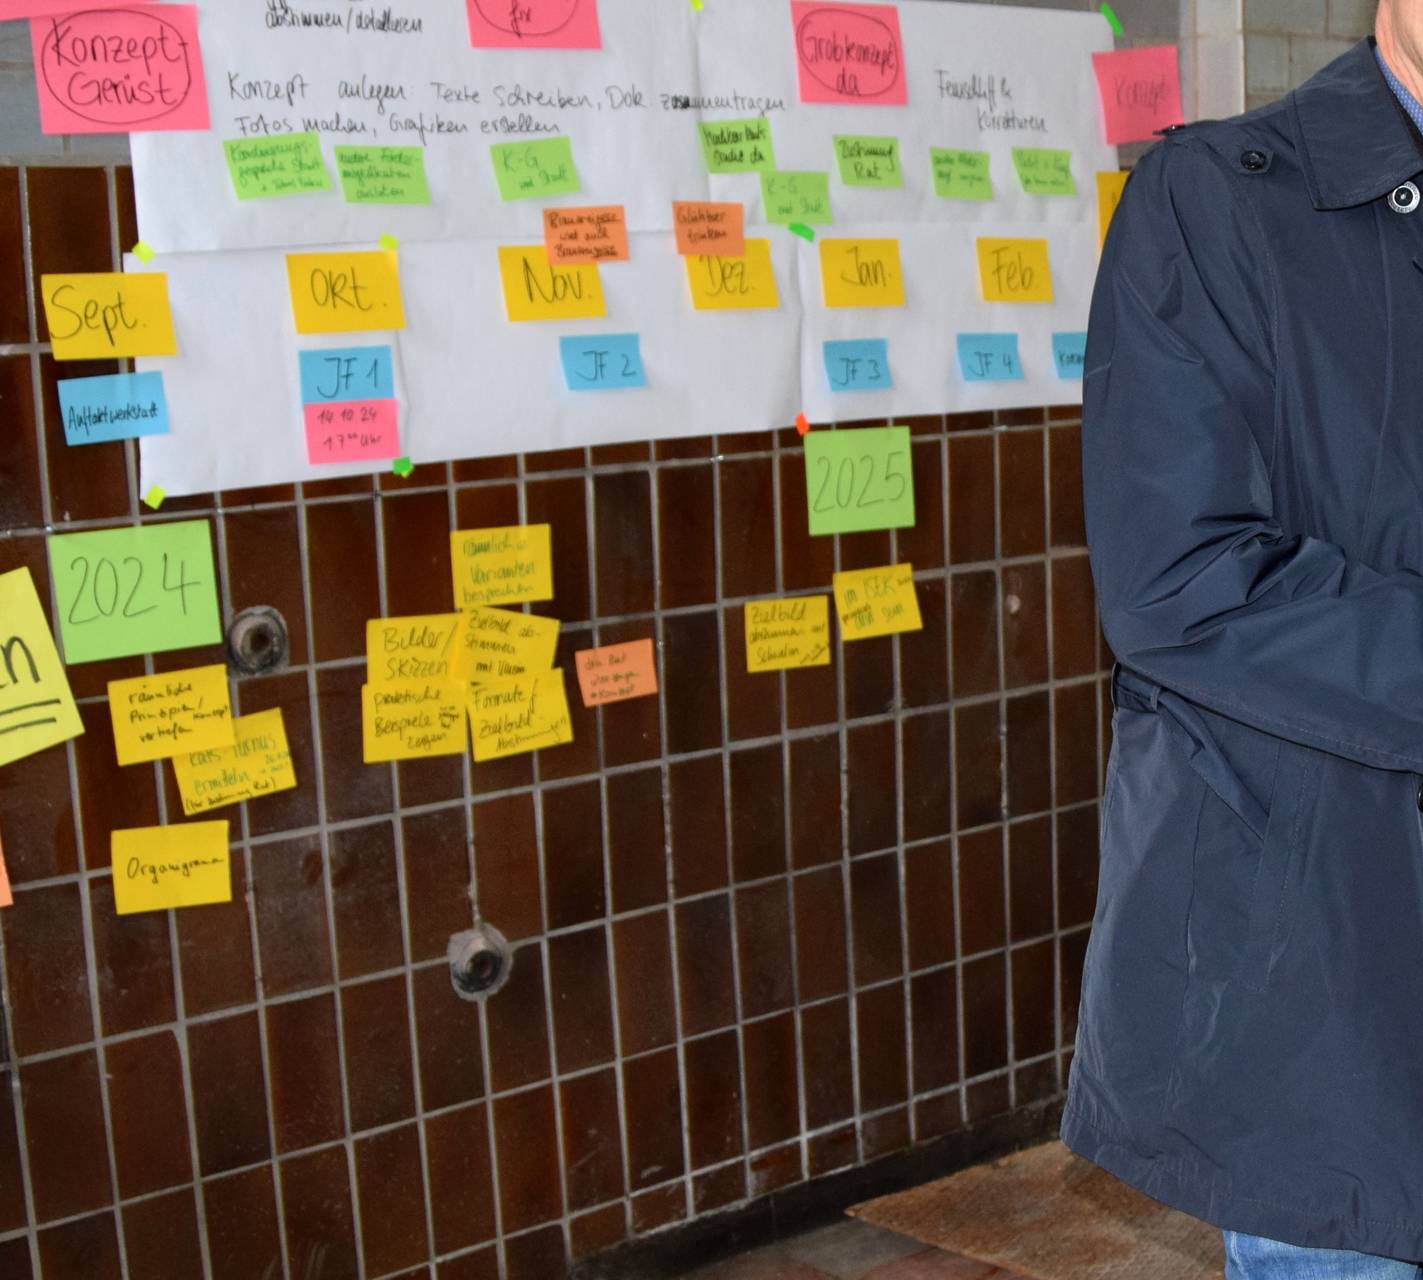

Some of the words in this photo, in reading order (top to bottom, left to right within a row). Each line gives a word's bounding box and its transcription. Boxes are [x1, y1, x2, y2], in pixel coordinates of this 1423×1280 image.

[68, 71, 179, 106] Gerüst
[227, 71, 309, 107] Konzept
[430, 81, 481, 105] Texte
[605, 84, 646, 110] Dok
[836, 67, 860, 97] da
[233, 113, 293, 136] Fotos
[389, 112, 468, 147] Grafiken
[480, 112, 560, 134] erstellen
[749, 144, 765, 164] da
[853, 160, 882, 180] Rat
[521, 256, 593, 304] Nov.
[839, 246, 893, 288] Jan.
[308, 265, 390, 313] Okt.
[49, 284, 148, 347] Sept.
[364, 352, 380, 389] 1
[620, 352, 637, 379] 2
[866, 358, 882, 381] 3
[1002, 350, 1013, 375] 4
[66, 403, 161, 435] Auftaktwerkstatt
[360, 432, 384, 448] Uhr
[812, 450, 907, 513] 2025
[67, 552, 202, 626] 2024
